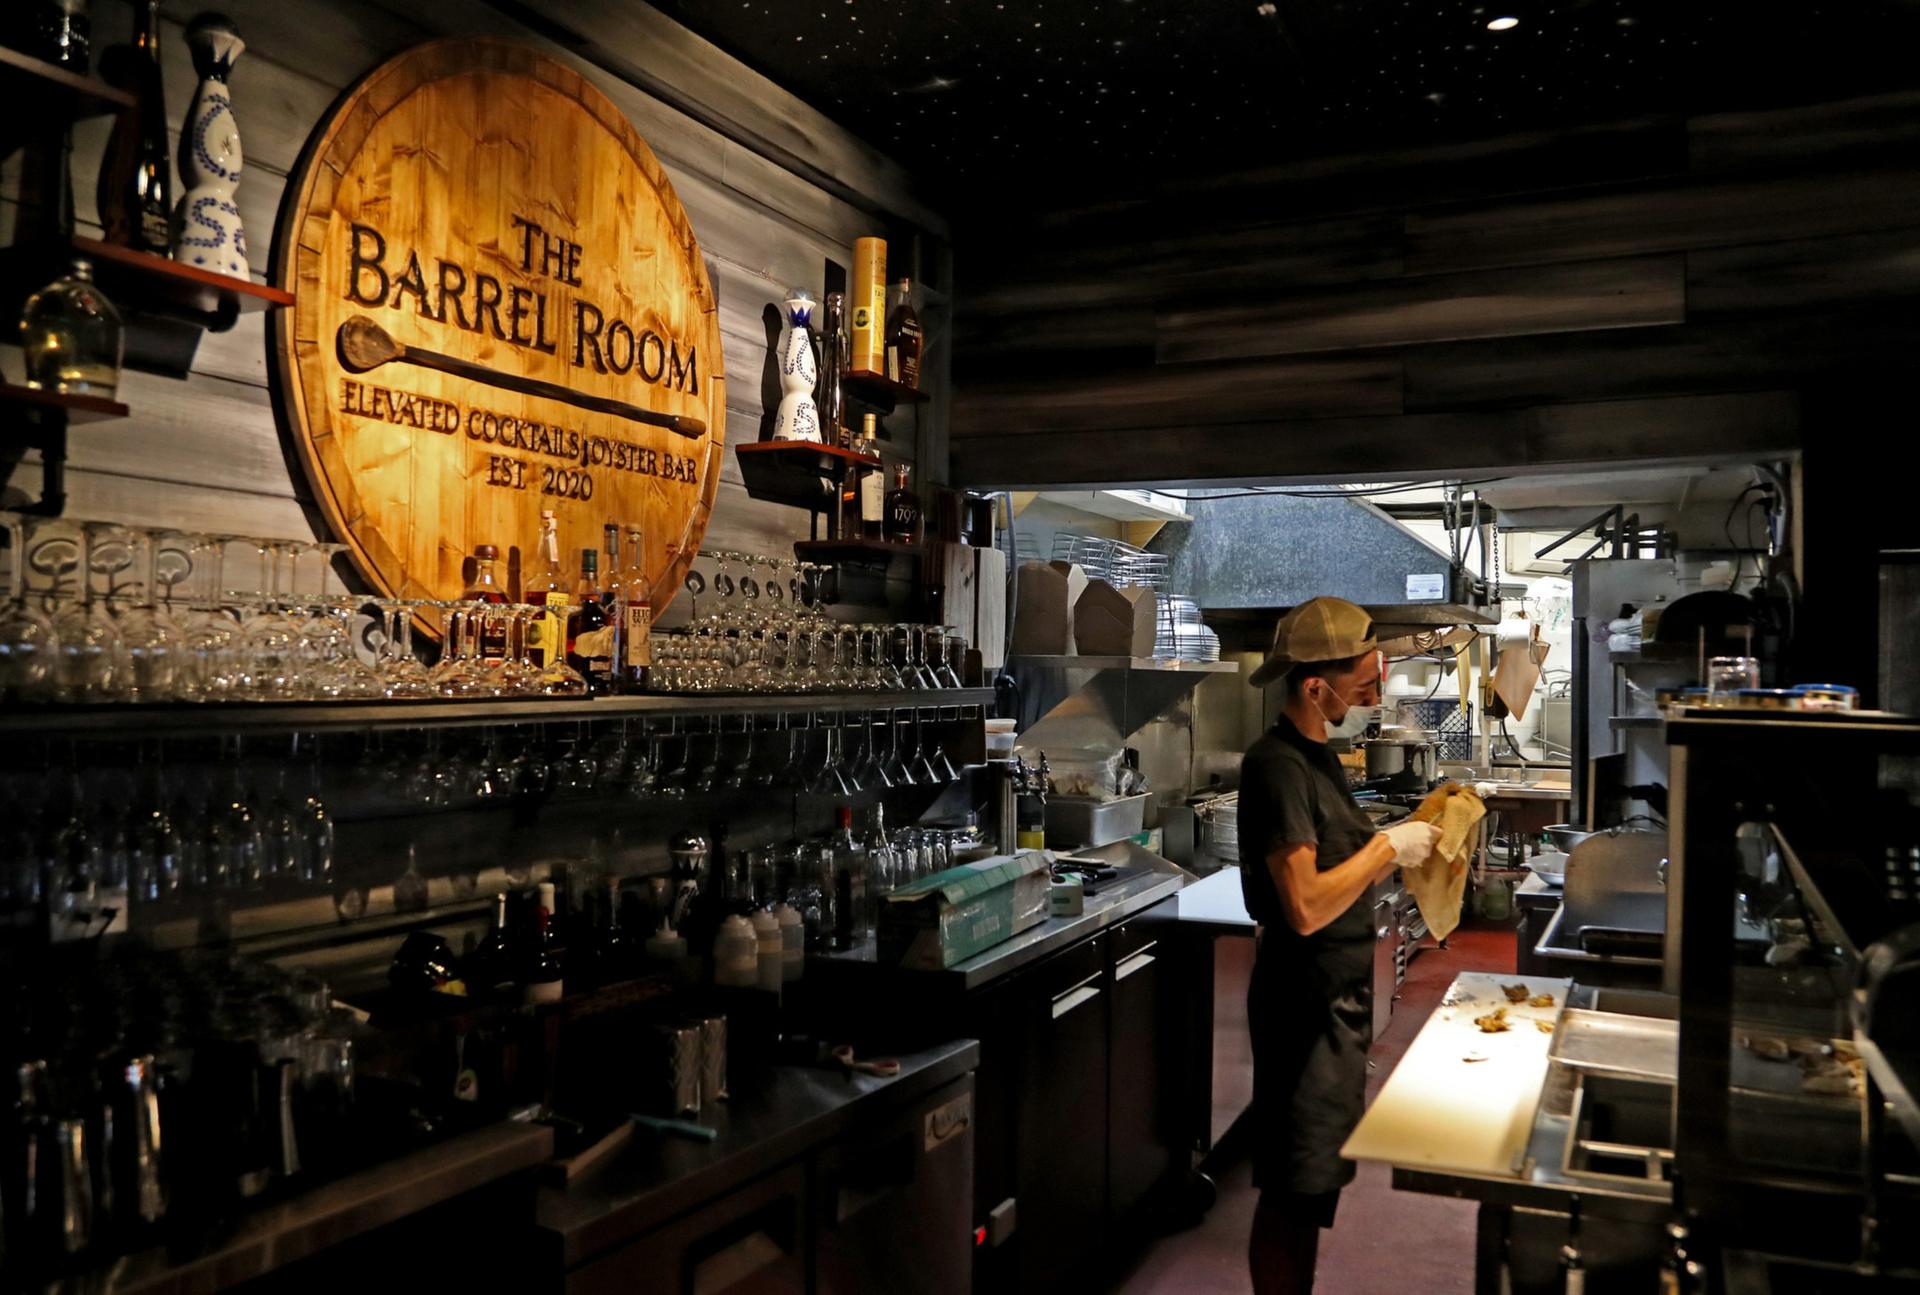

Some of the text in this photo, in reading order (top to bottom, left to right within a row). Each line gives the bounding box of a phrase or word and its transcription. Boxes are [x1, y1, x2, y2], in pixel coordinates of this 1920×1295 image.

[512, 213, 583, 288] THE
[344, 221, 698, 396] BARREL ROOM
[340, 378, 698, 485] ELEVATED COCKTAILS OYSTER BAR
[541, 466, 593, 501] 2020
